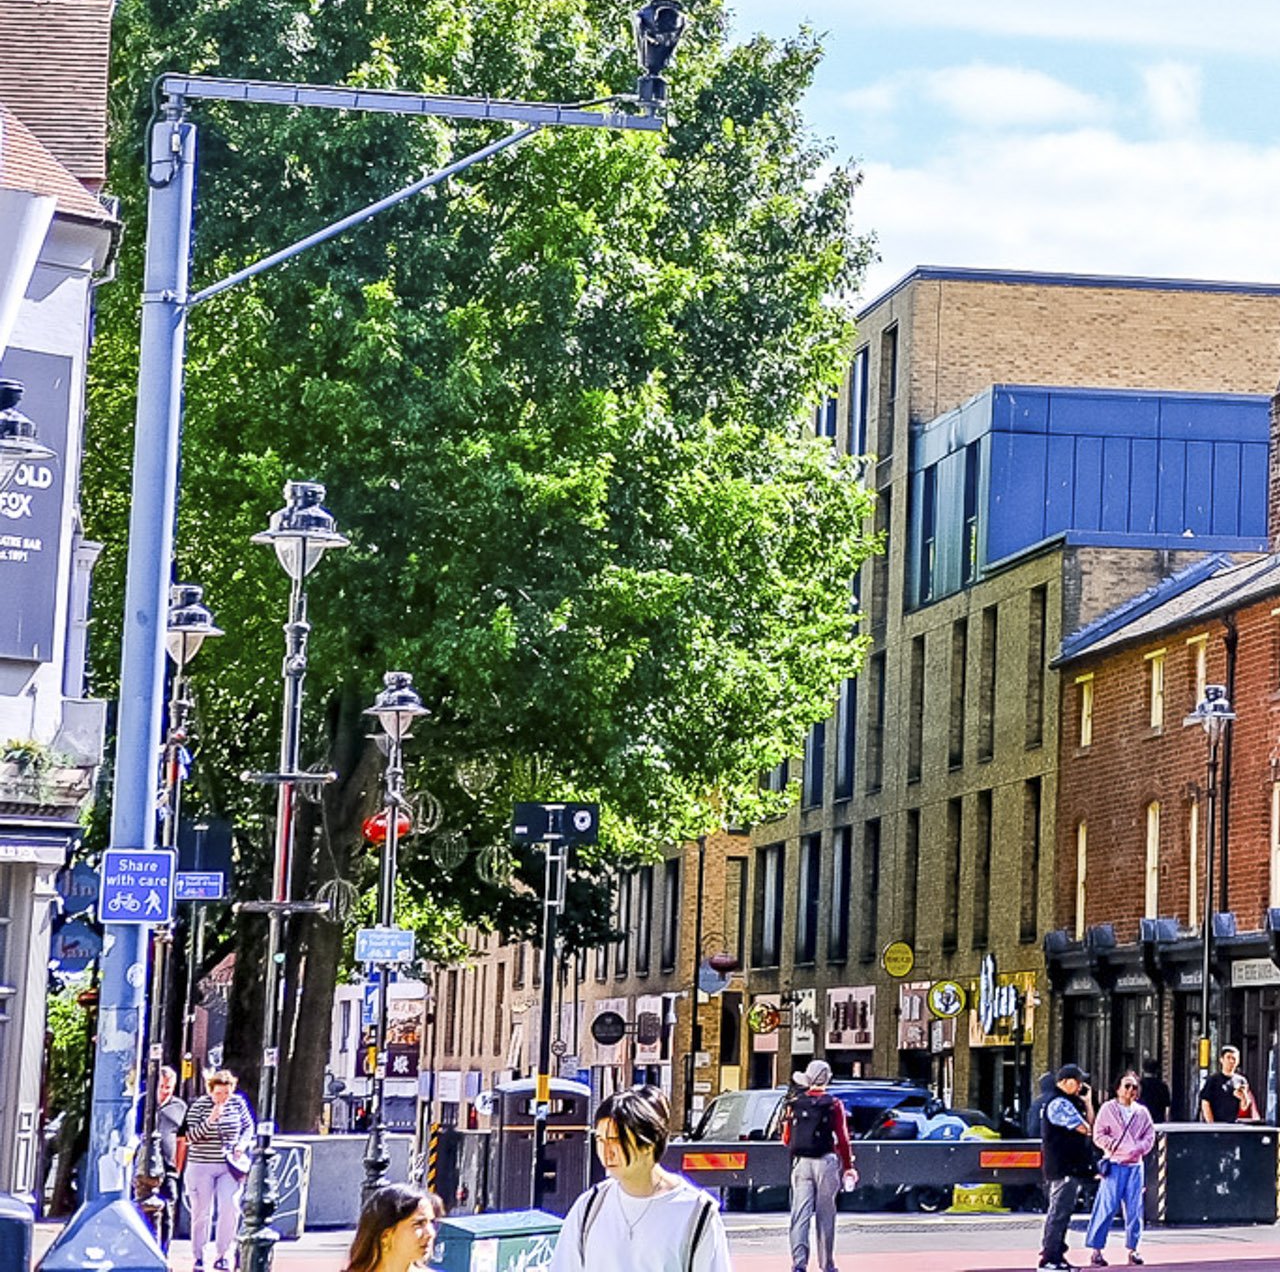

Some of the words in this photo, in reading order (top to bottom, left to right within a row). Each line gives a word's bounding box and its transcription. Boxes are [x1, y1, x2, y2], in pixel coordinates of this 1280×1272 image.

[14, 463, 53, 489] OLD
[118, 858, 159, 872] Share
[106, 874, 137, 887] with
[138, 876, 168, 887] care
